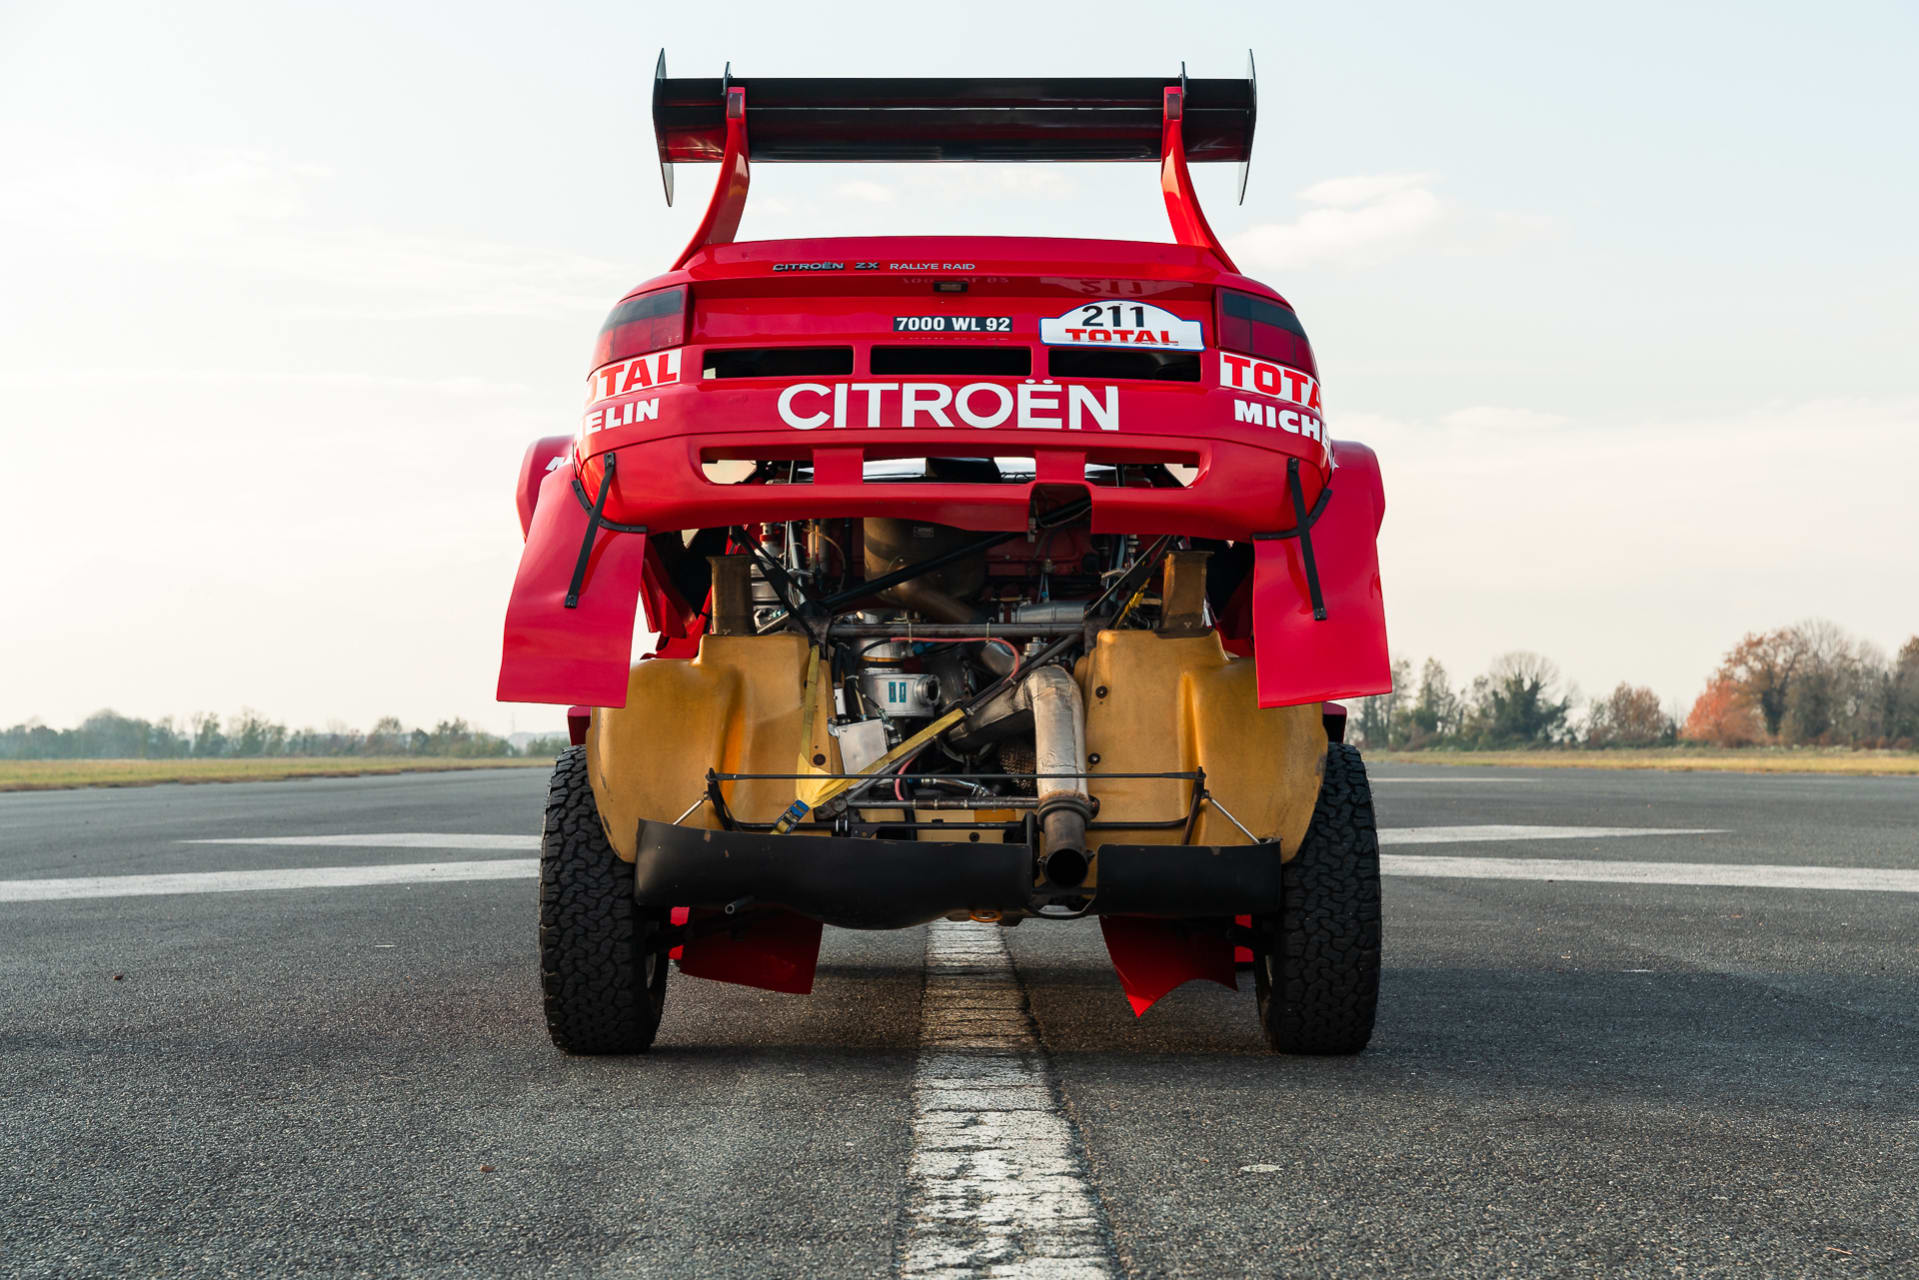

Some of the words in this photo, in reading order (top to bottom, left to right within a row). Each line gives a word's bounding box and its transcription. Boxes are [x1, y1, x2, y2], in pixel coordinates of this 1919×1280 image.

[772, 262, 845, 272] CITROËN
[854, 261, 880, 271] ZX
[896, 316, 946, 332] 7000
[951, 317, 981, 332] WL
[985, 317, 1011, 332] 92
[1082, 305, 1145, 328] 211
[1065, 328, 1179, 345] TOTAL
[777, 378, 1120, 430] CITROËN
